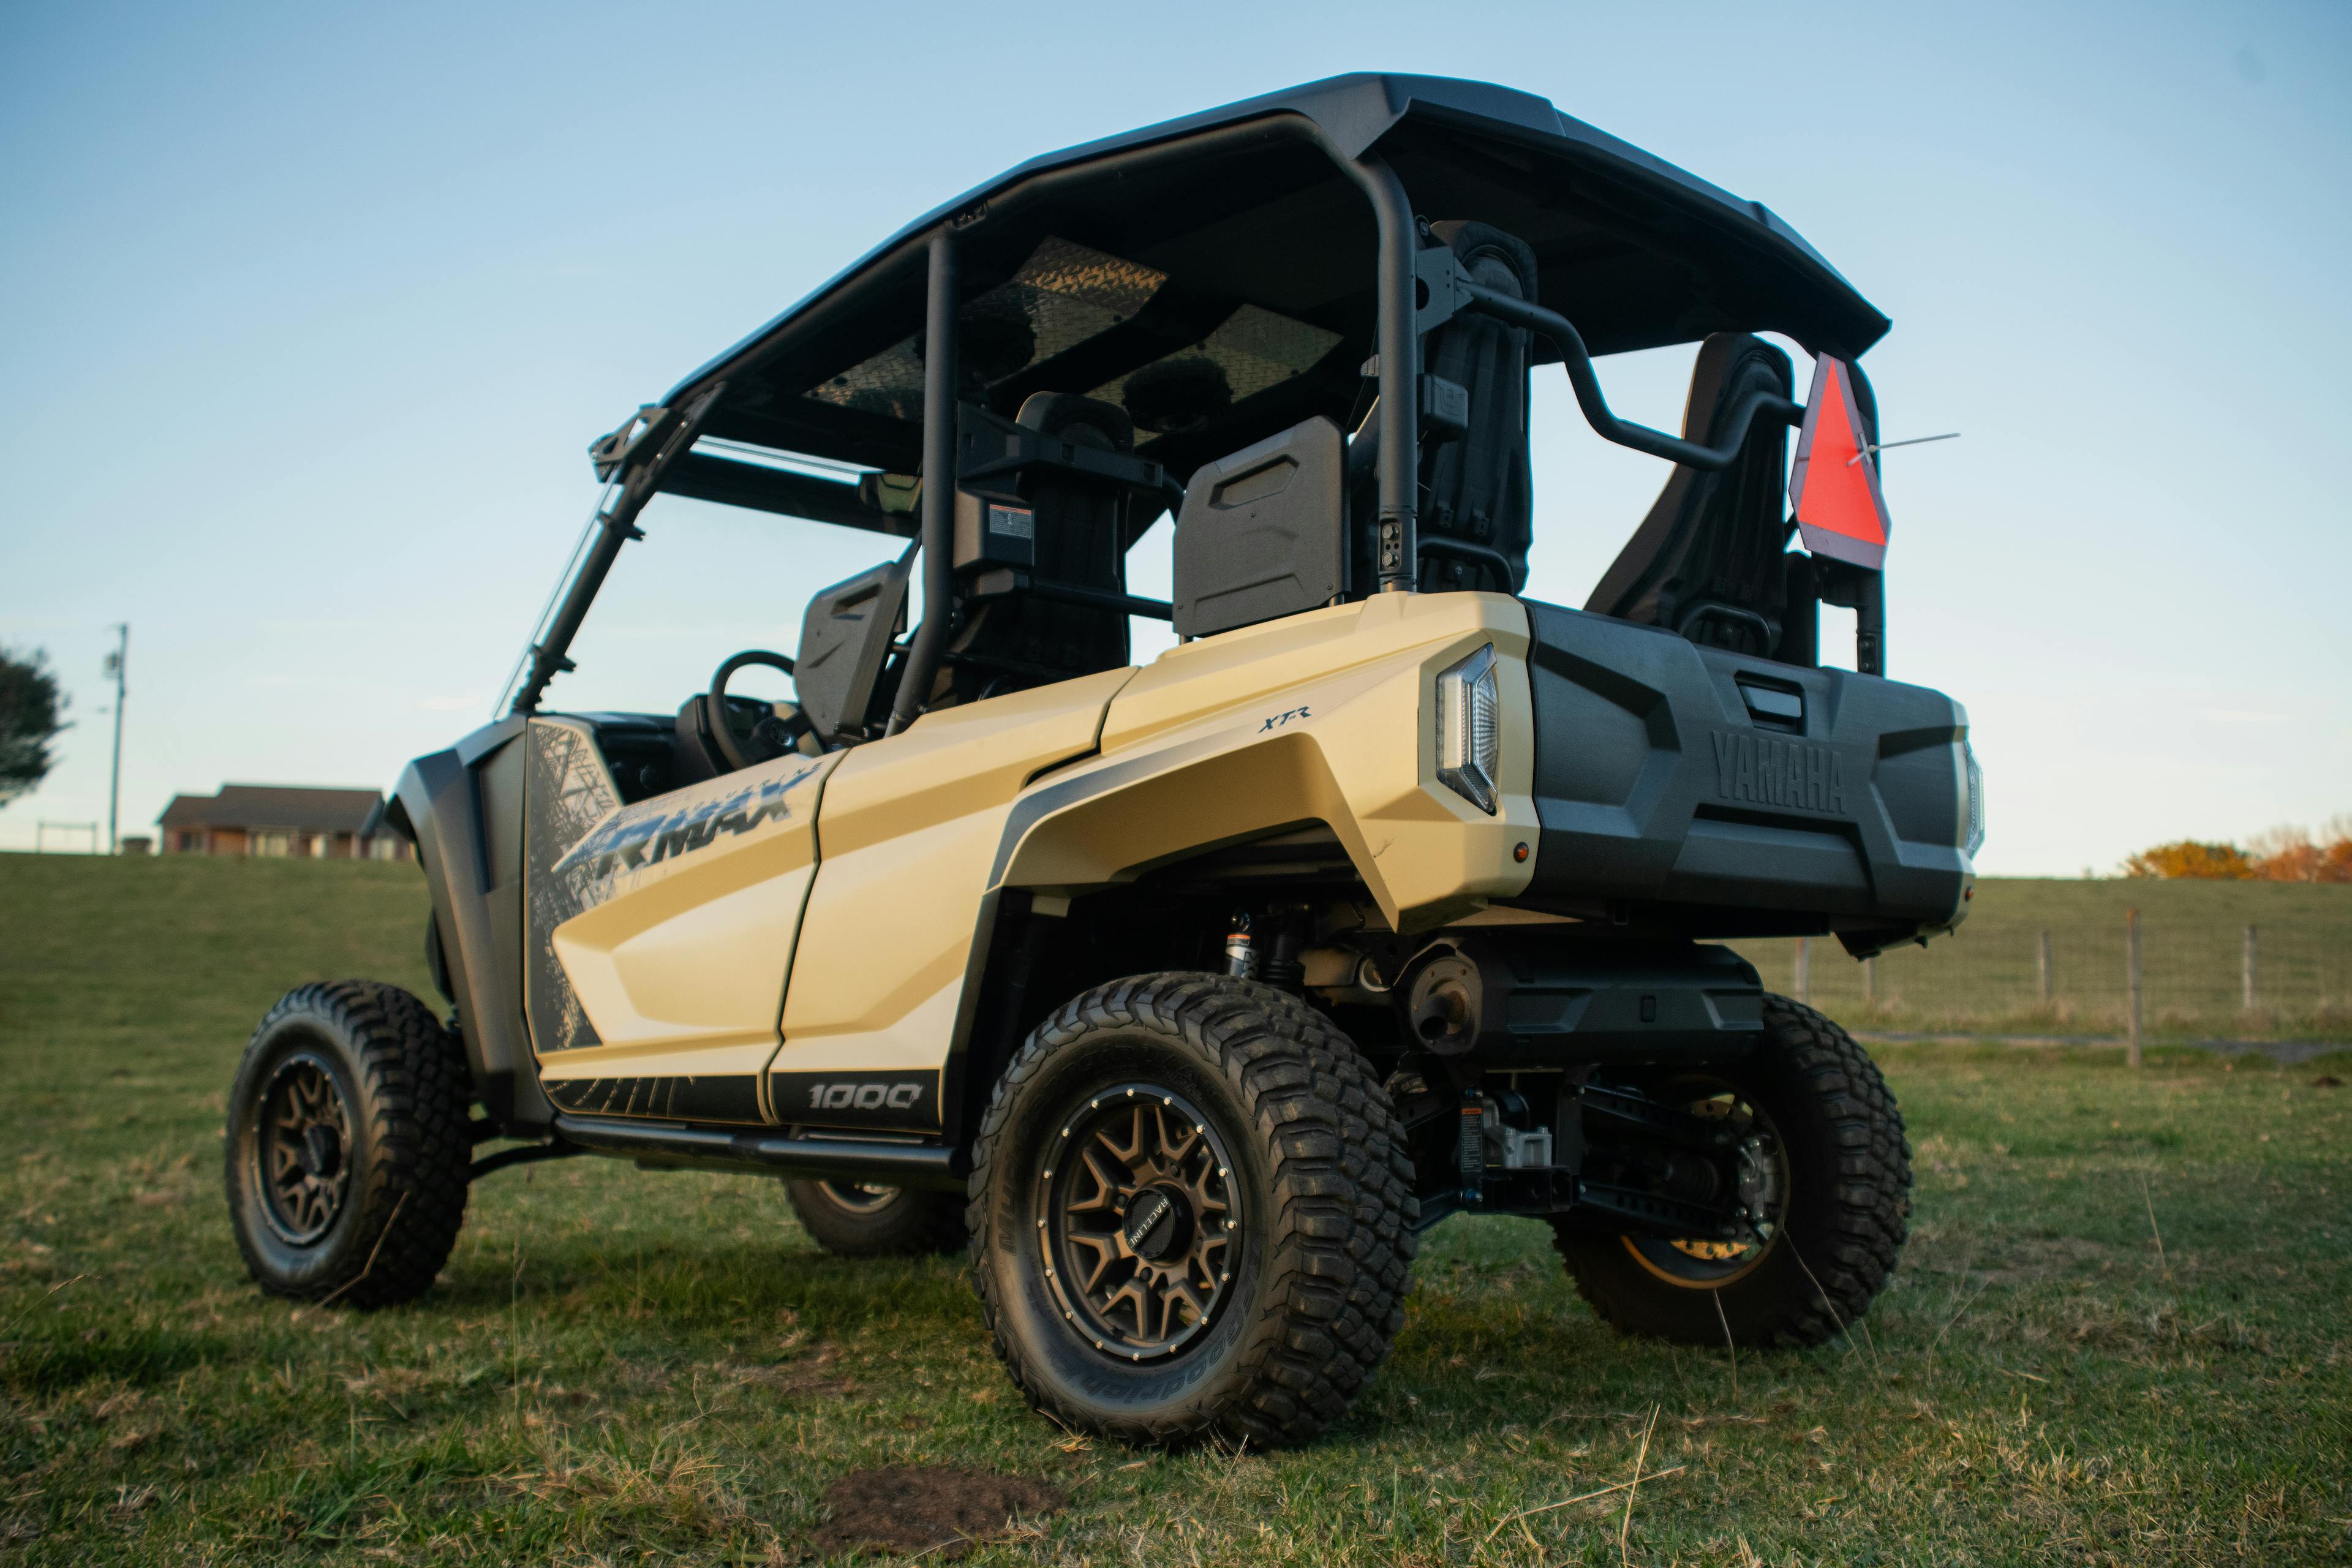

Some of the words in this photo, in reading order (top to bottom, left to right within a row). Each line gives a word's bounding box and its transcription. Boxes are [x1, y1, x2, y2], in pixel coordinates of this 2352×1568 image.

[1712, 731, 1846, 814] YAMAHA
[808, 1084, 924, 1109] 1000
[1127, 1198, 1169, 1249] RACELINE
